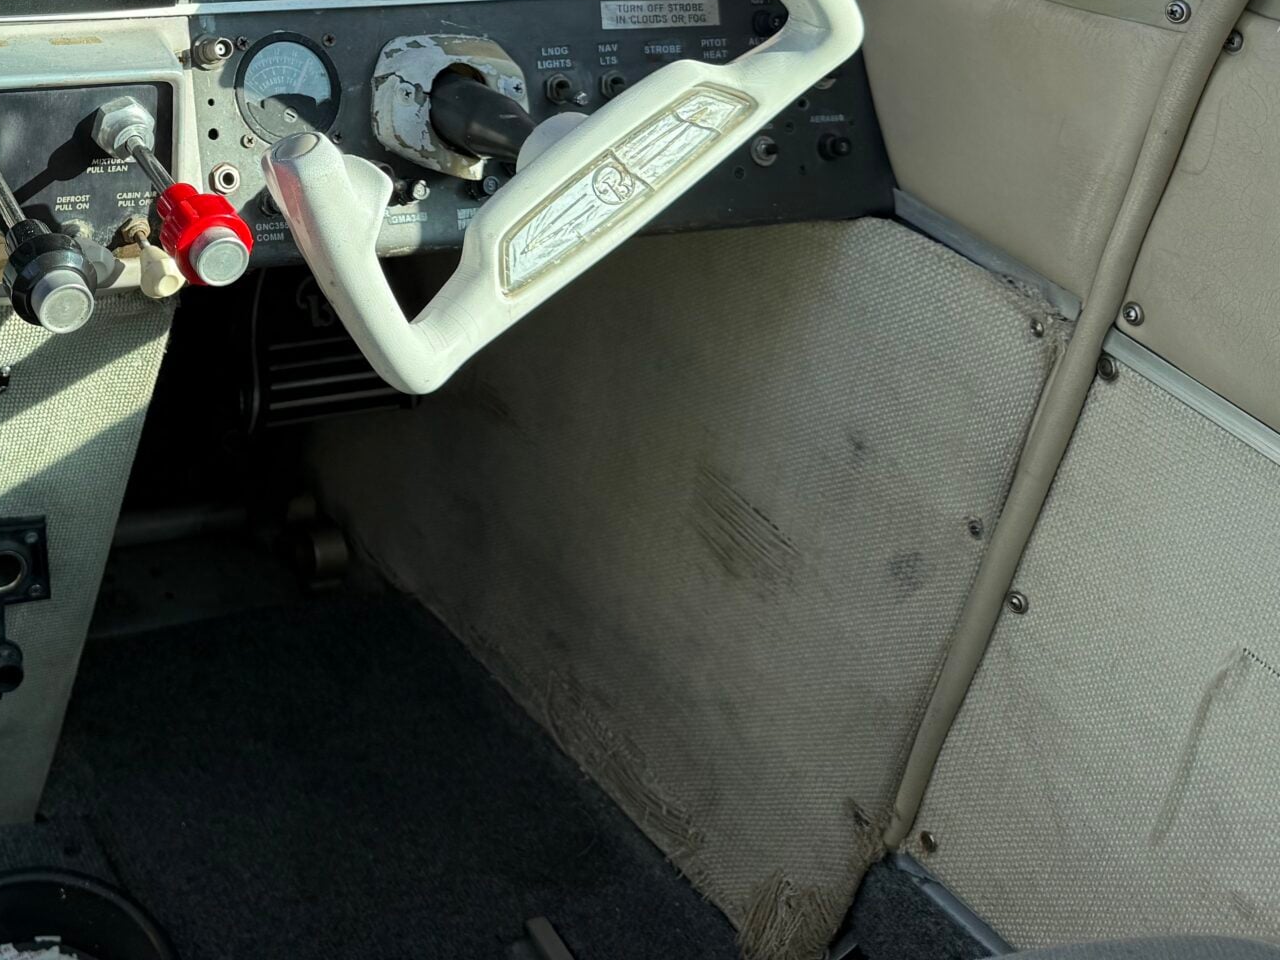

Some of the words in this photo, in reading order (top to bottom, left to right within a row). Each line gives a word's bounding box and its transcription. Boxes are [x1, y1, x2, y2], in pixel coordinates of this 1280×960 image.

[616, 4, 643, 13] TURN
[647, 3, 664, 13] OFF
[668, 2, 704, 13] STROBE
[615, 14, 626, 24] IN
[629, 13, 668, 24] CLOUDS
[671, 13, 686, 24] OR
[688, 13, 707, 23] FOG
[541, 46, 568, 56] LNDG
[598, 44, 618, 53] NAV
[644, 44, 682, 54] STROBE
[537, 59, 572, 70] LIGHTS
[600, 56, 618, 65] LTS
[87, 166, 105, 174] PULL
[56, 195, 91, 203] DEFROST
[55, 203, 73, 211] PULL
[256, 233, 284, 241] COMM
